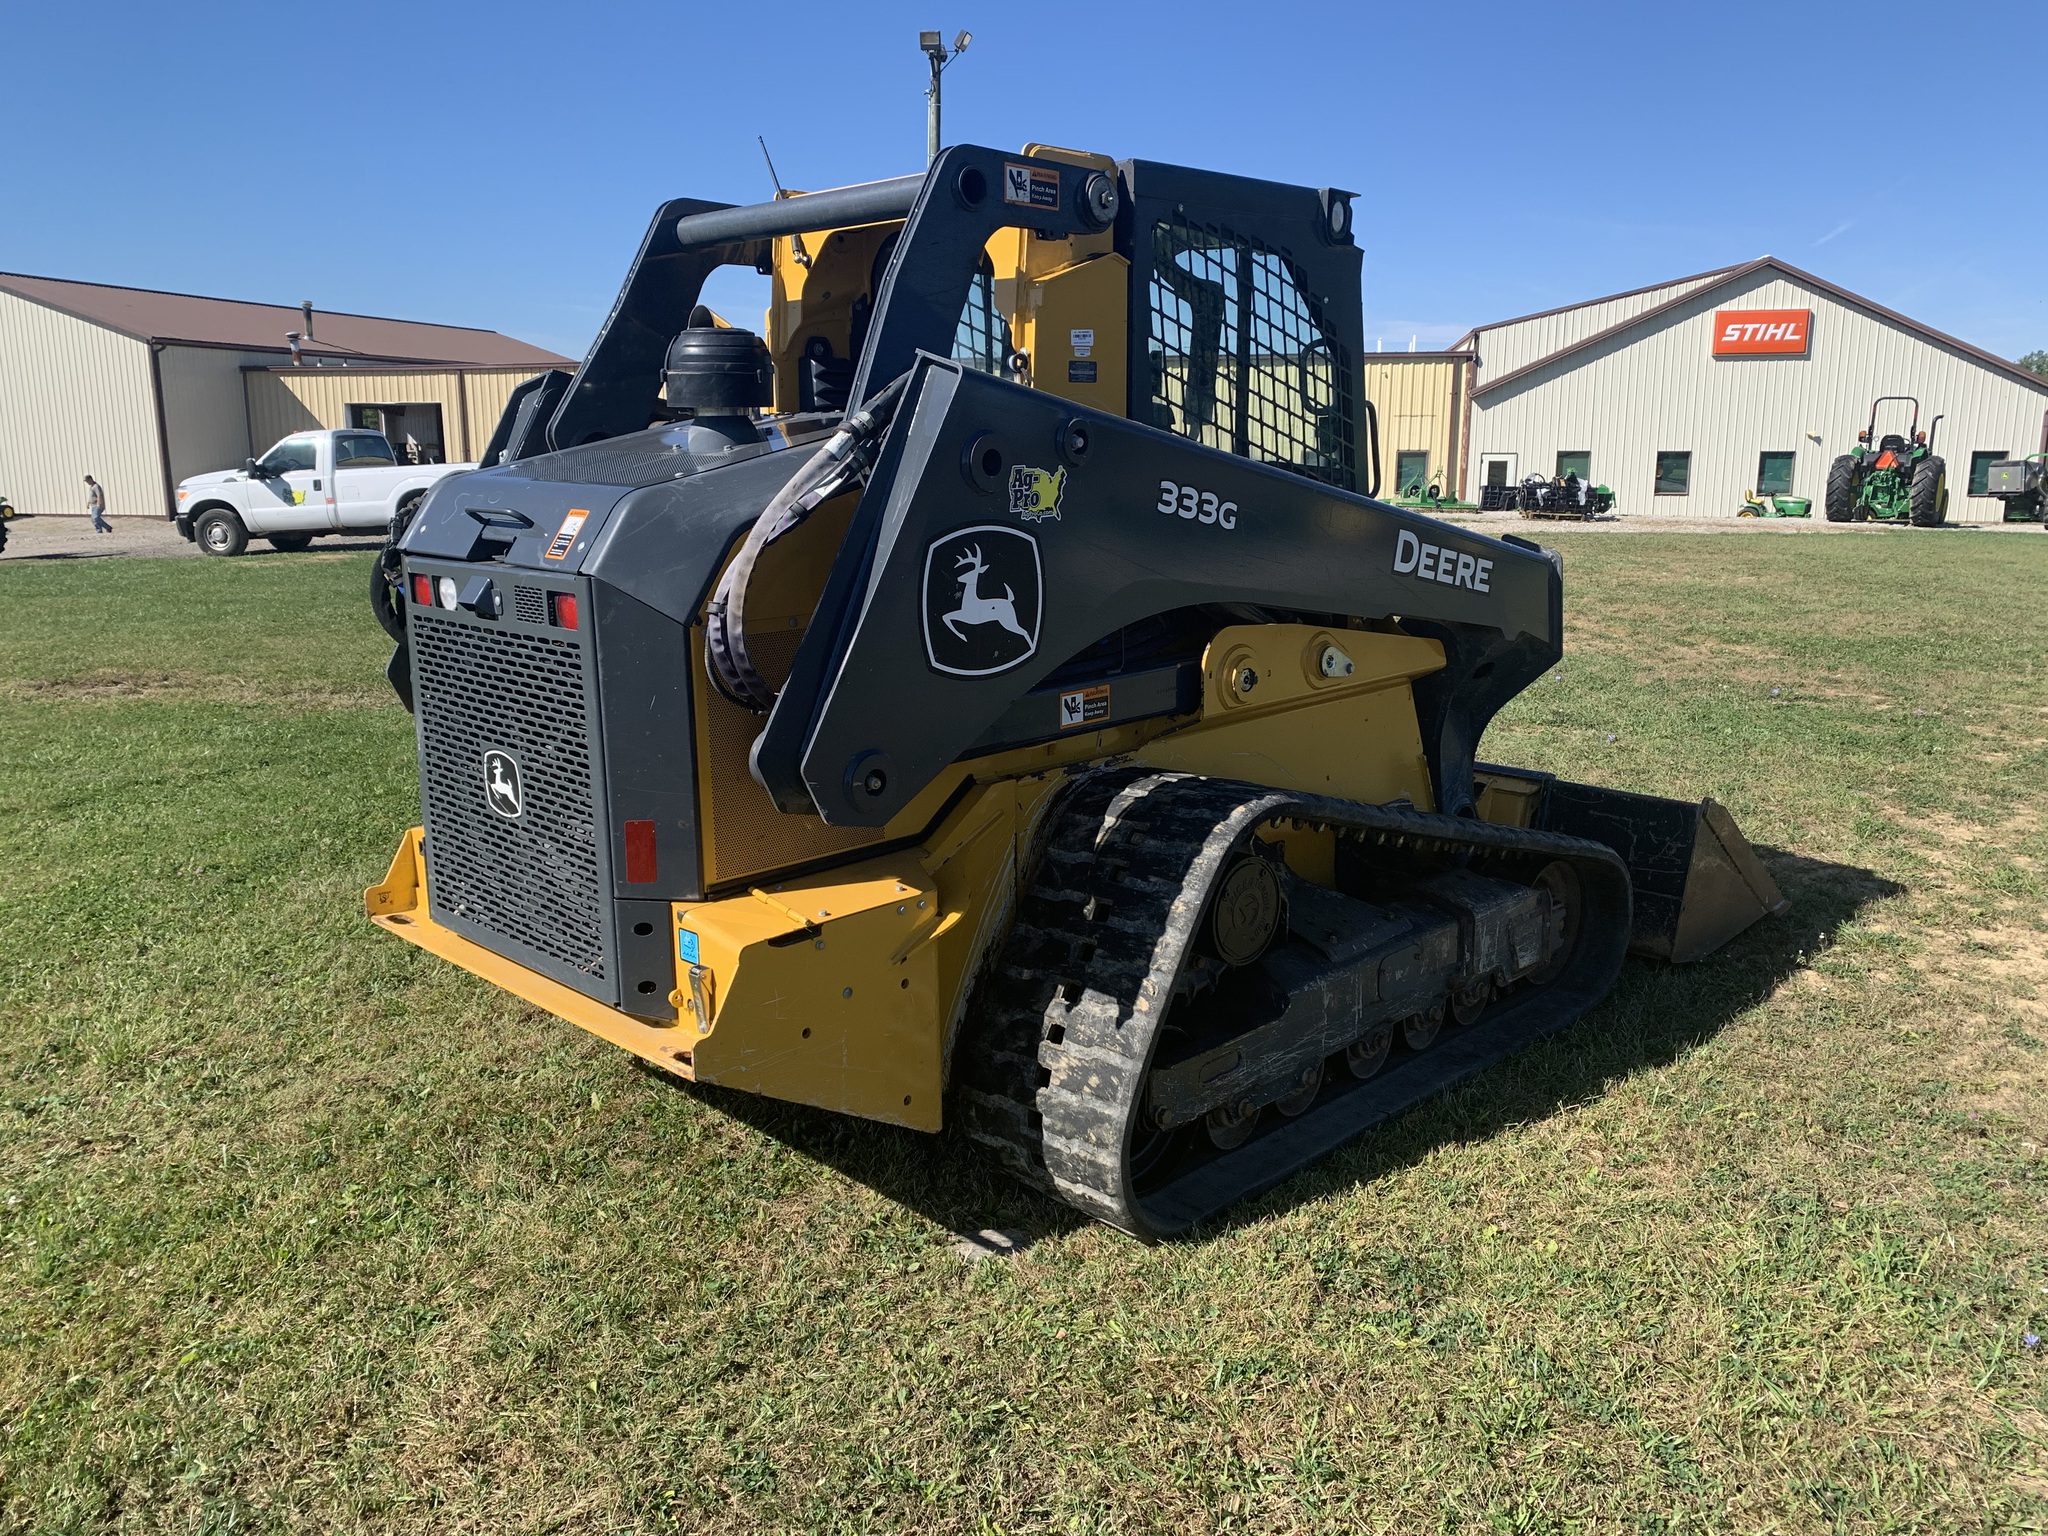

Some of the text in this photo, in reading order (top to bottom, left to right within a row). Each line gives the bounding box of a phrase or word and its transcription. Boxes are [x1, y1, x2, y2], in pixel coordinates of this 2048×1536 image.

[1031, 184, 1057, 195] Pinch Area
[1721, 323, 1802, 341] STIHL
[1011, 489, 1040, 509] Pro
[1157, 480, 1238, 530] 333G
[1393, 528, 1494, 593] DEERE
[1084, 702, 1097, 710] Pinch
